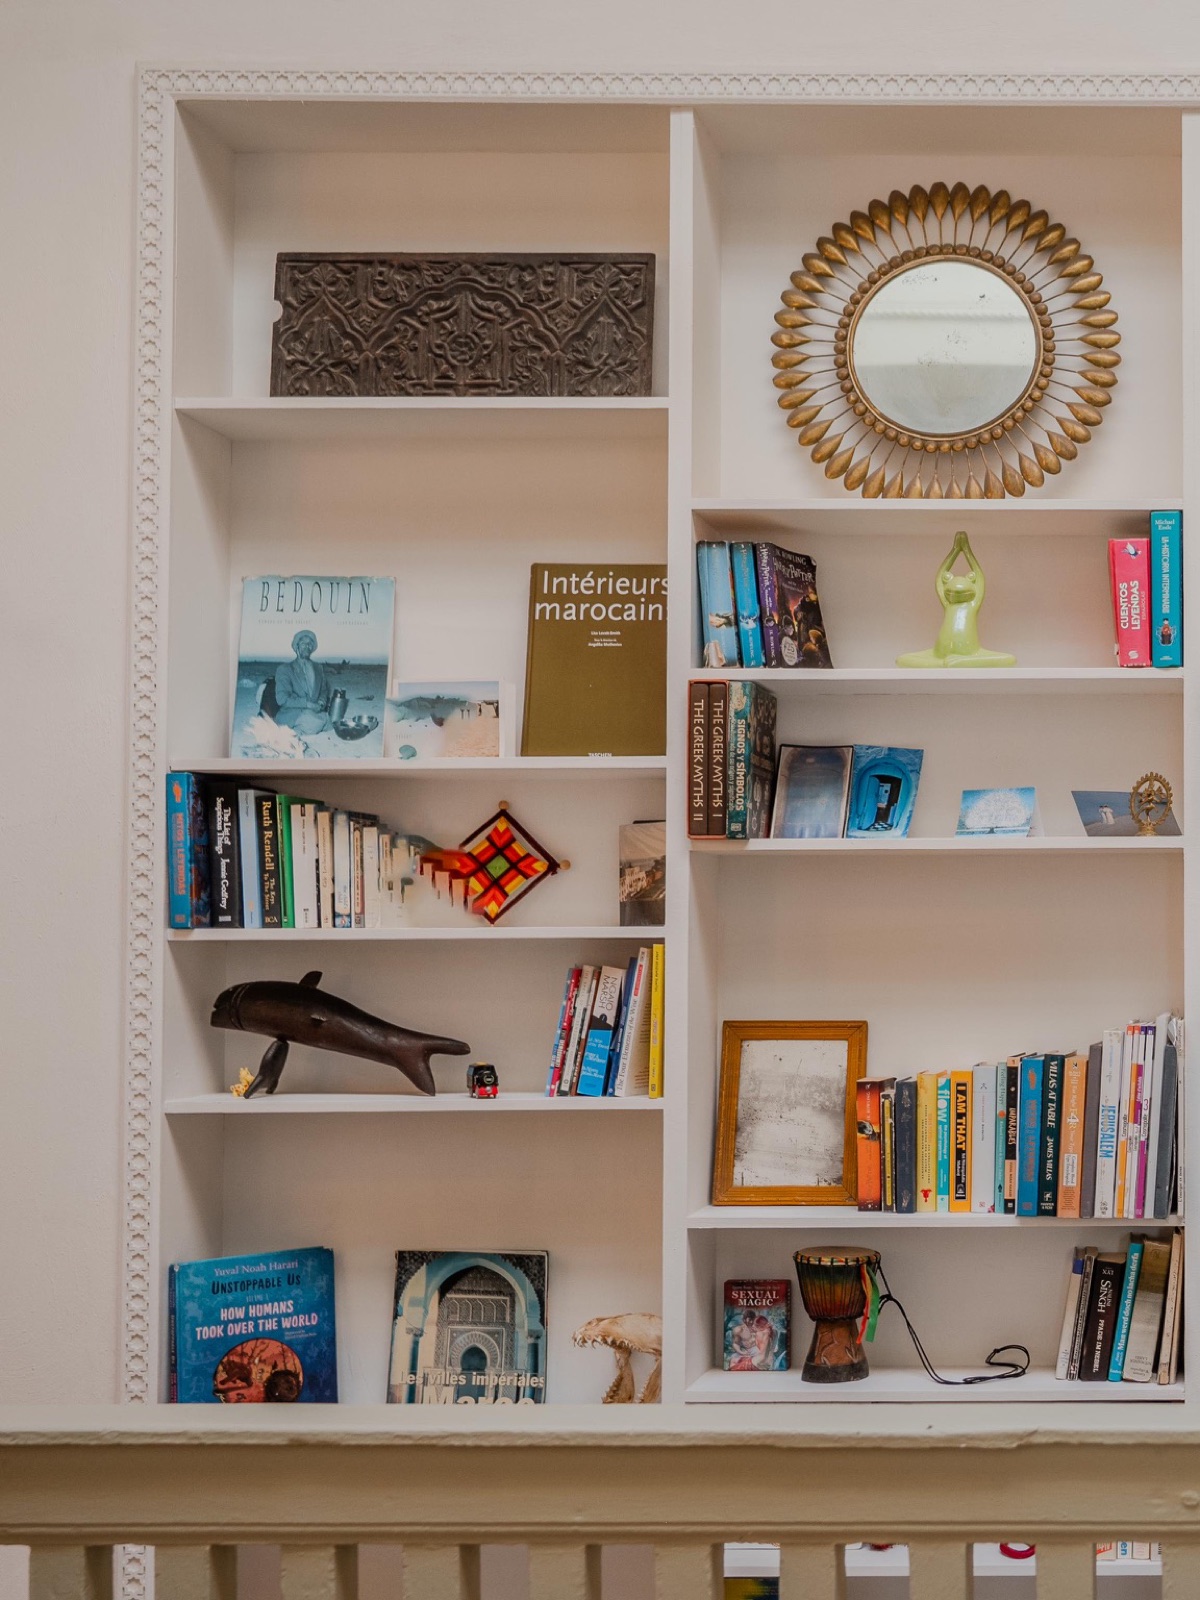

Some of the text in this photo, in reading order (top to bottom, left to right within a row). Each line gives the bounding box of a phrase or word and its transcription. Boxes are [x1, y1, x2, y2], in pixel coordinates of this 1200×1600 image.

[258, 580, 371, 614] BEDOUIN
[1120, 582, 1130, 629] CUENTOS
[1130, 580, 1141, 630] LEYENDAS
[693, 699, 704, 724] THE
[693, 726, 704, 763] GREEK
[713, 699, 724, 798] THE GREEK MYTHS
[736, 718, 746, 754] SIGNOS
[693, 765, 704, 798] MYTHS
[735, 762, 747, 811] SÍMBOLOS
[215, 797, 226, 856] Suspicious Things
[223, 809, 233, 846] The List of
[262, 801, 275, 870] Ruth Rendell
[177, 813, 187, 896] MITOS LEYENDAS
[218, 880, 230, 910] Godfrey
[598, 974, 611, 1010] MARSH
[605, 976, 618, 1012] NGAIO
[614, 998, 637, 1091] The Four Elements the Wise
[956, 1094, 967, 1114] AM
[997, 1068, 1007, 1106] Feeling Happy
[1047, 1060, 1058, 1129] VILLAS AT TABLE
[937, 1088, 951, 1123] flow
[957, 1117, 967, 1151] THAT
[1007, 1107, 1017, 1146] IMPARABLES
[1099, 1104, 1117, 1159] JERUSALEM
[1141, 1114, 1149, 1138] Cosmopolite
[1045, 1135, 1055, 1181] JAMES VILLAS
[213, 1259, 300, 1277] Yuval Noah Harari
[1127, 1272, 1136, 1290] lacha
[220, 1300, 295, 1321] HOW HUMANS
[731, 1290, 780, 1299] SEXUAL
[738, 1298, 774, 1307] MAGIC
[1097, 1279, 1112, 1313] SINGH
[1106, 1289, 1114, 1307] NALINI
[1122, 1299, 1131, 1316] doch
[1126, 1290, 1133, 1299] no
[195, 1312, 319, 1342] TOOK OVER THE WORLD
[1120, 1316, 1129, 1334] werd
[1092, 1319, 1106, 1373] PFADE IM NEBEL
[1117, 1334, 1126, 1351] Man
[400, 1371, 546, 1388] Les villes impériales
